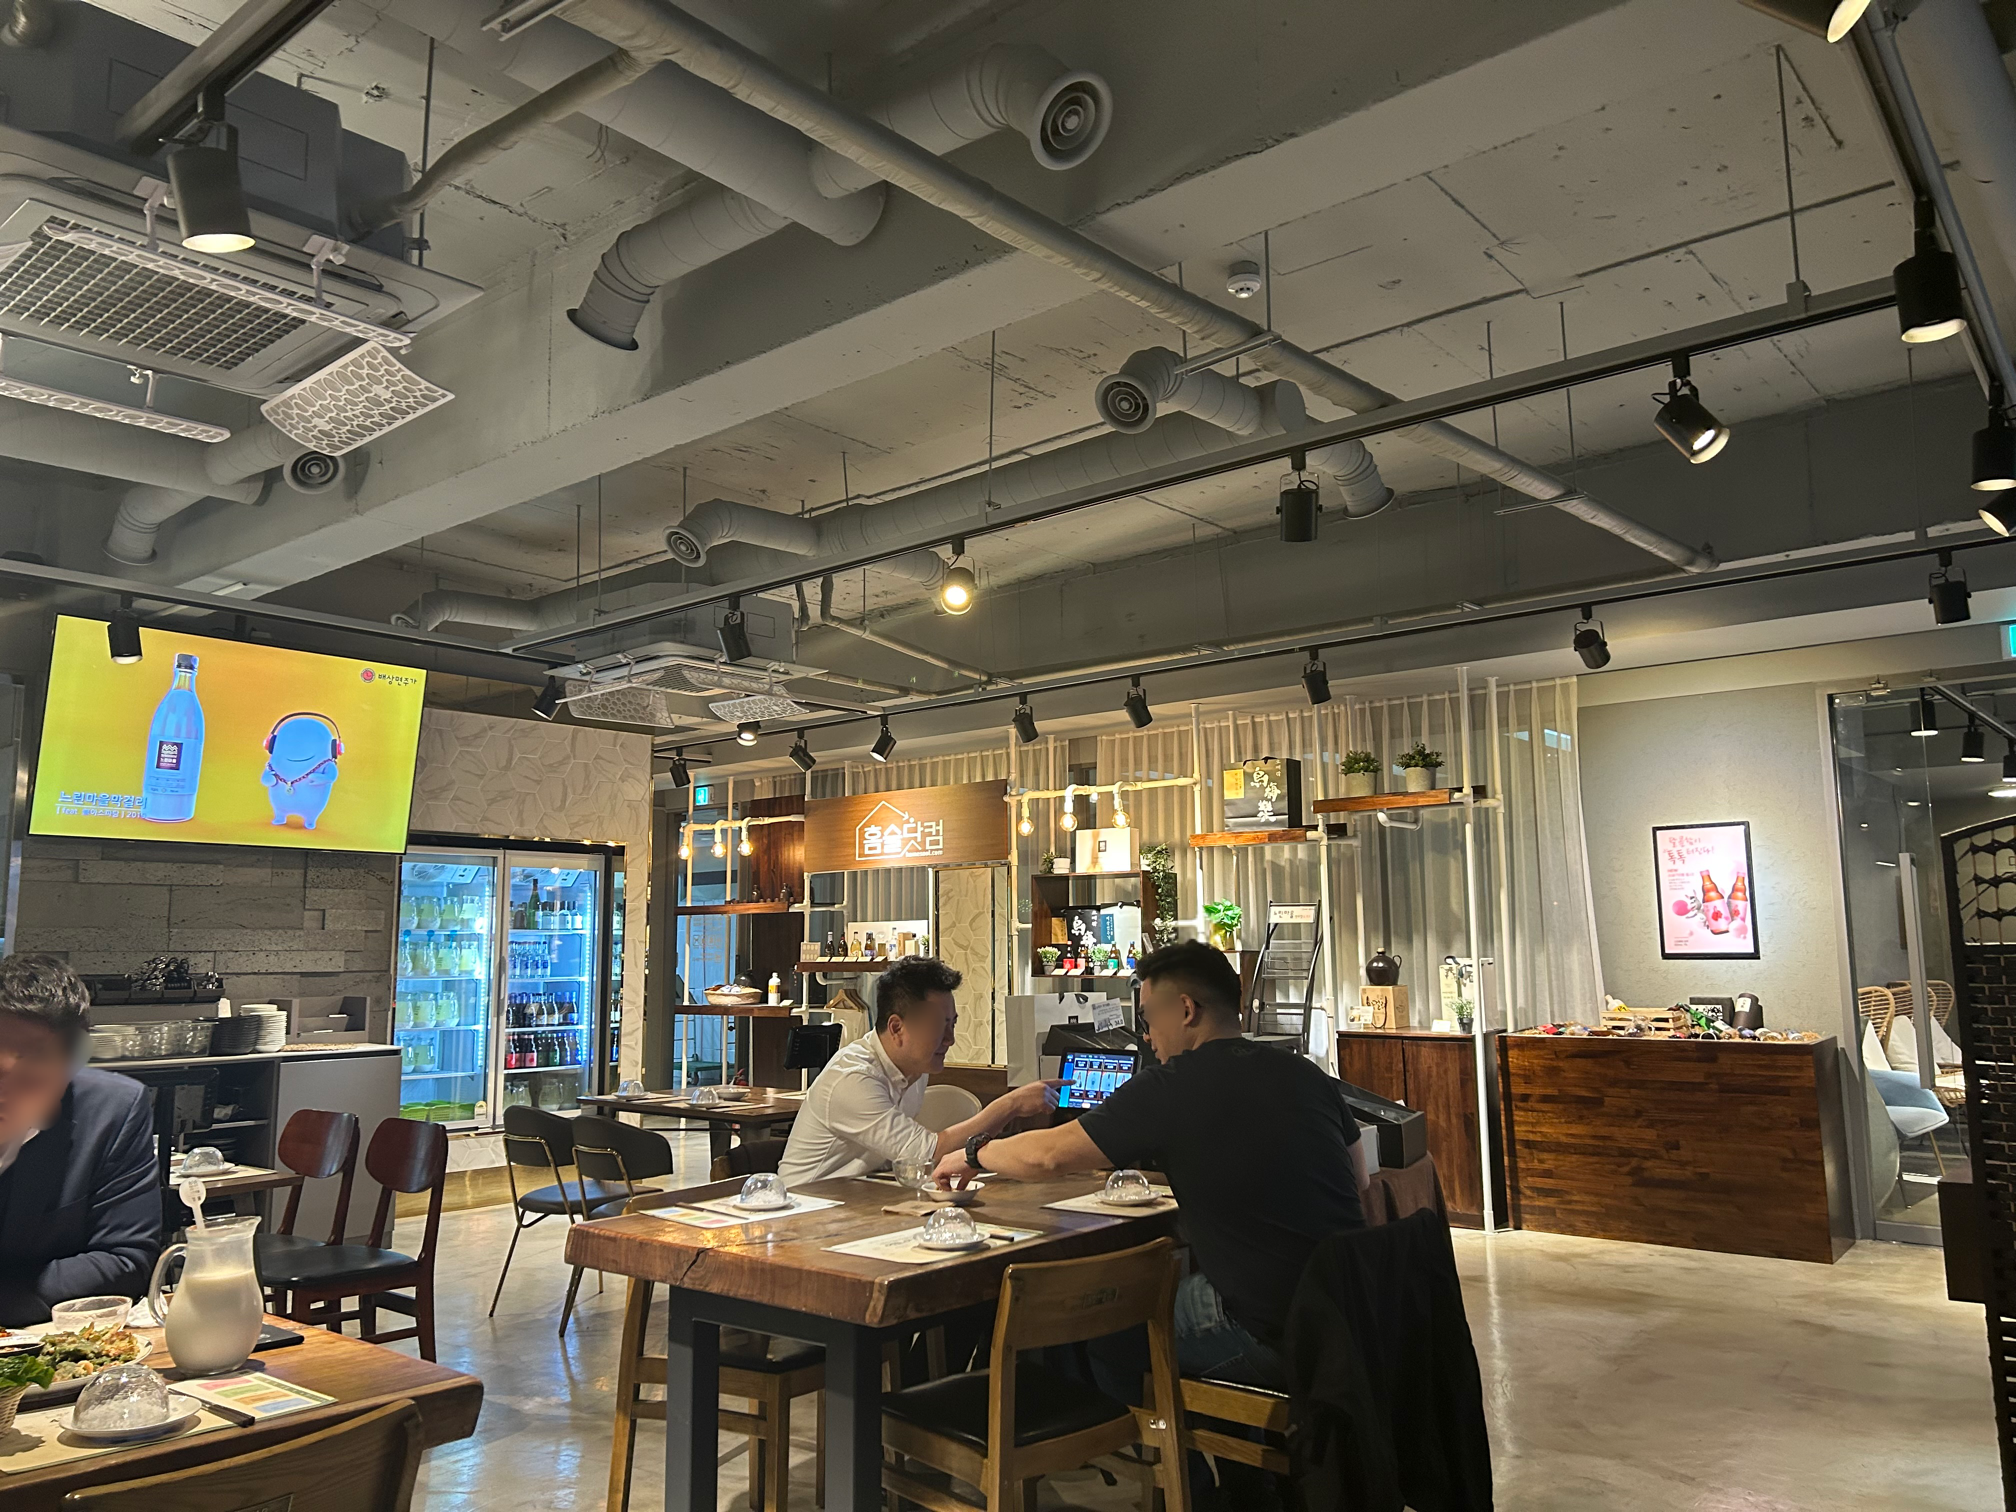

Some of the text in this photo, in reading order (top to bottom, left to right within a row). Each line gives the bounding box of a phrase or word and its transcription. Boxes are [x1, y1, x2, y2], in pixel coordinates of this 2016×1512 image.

[378, 674, 417, 686] 배상면주가
[58, 790, 148, 809] 느린마을막걸리
[863, 817, 943, 855] 홈술닷컴
